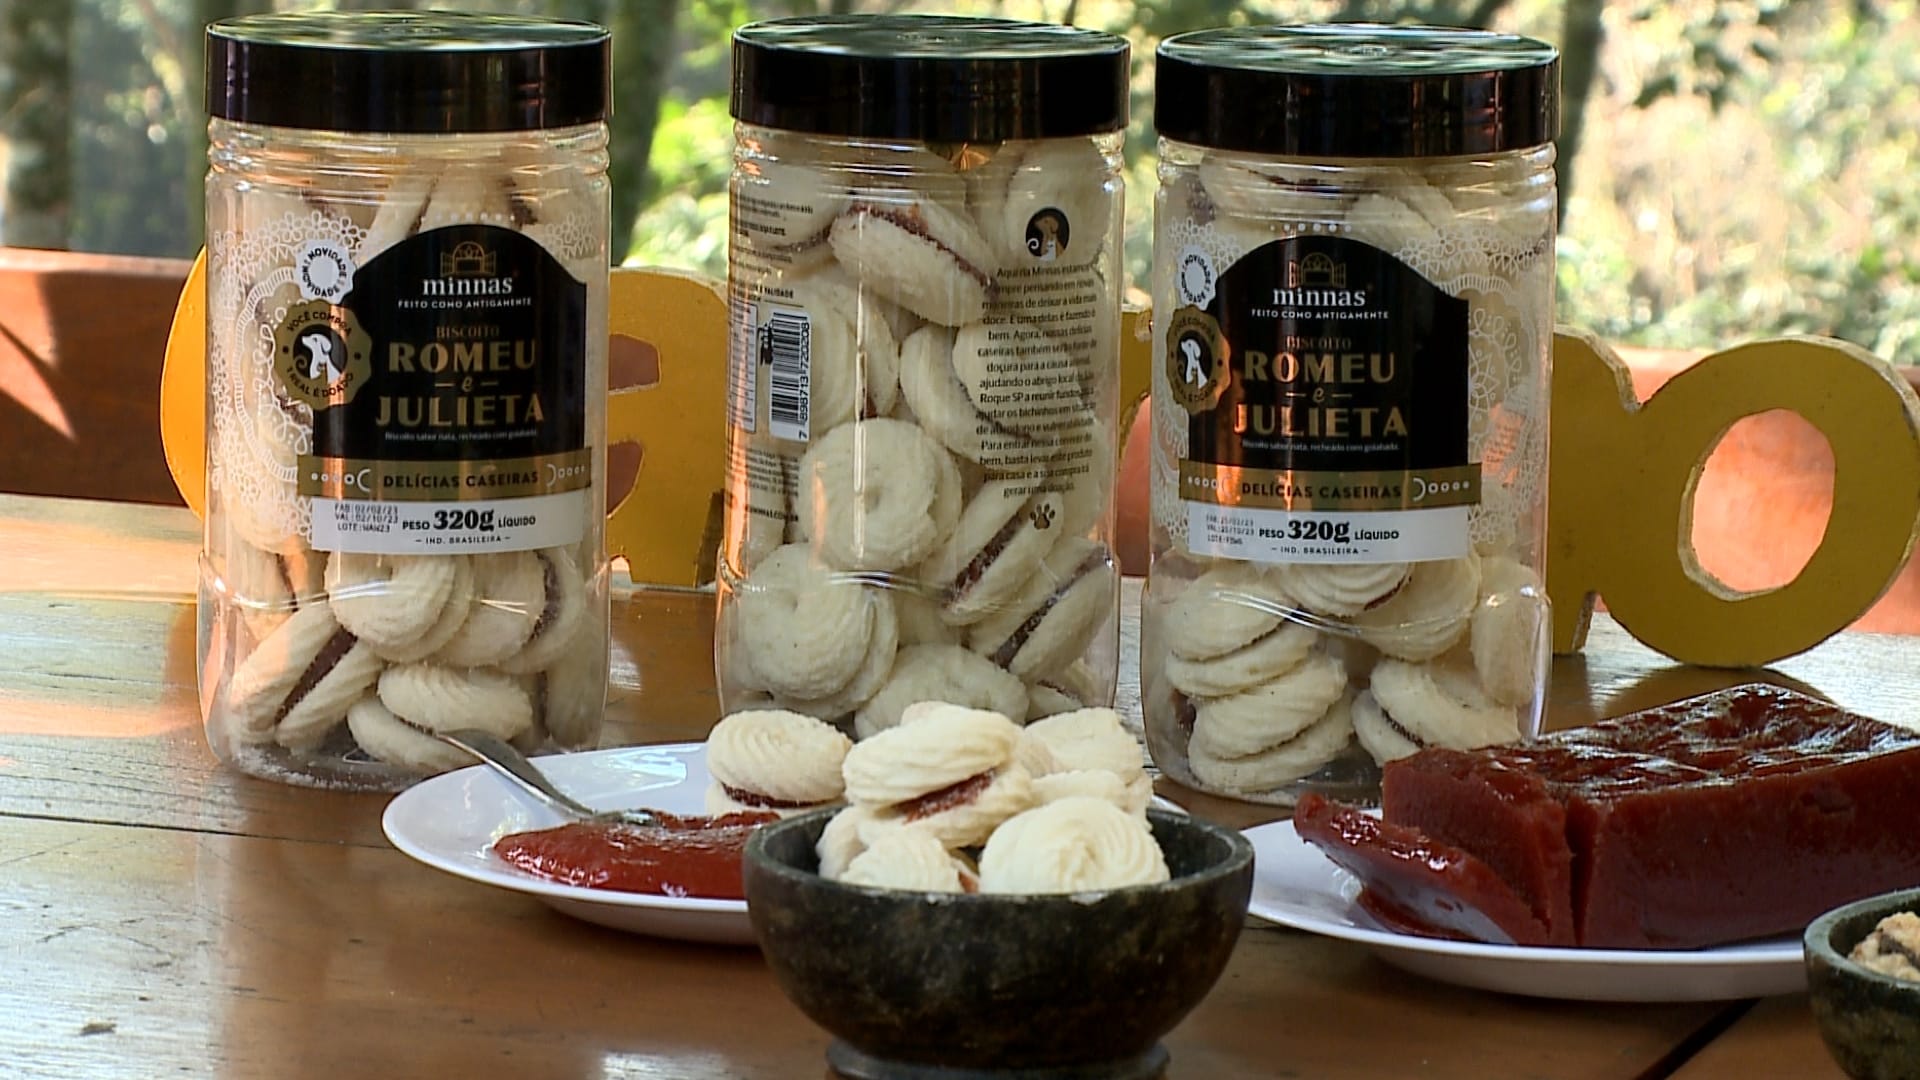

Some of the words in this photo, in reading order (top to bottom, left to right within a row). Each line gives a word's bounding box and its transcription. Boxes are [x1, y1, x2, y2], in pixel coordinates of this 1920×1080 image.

[423, 276, 513, 296] minnas
[398, 299, 428, 309] FEITO
[431, 300, 463, 309] COMO
[466, 297, 532, 309] ANTIGAMENTE
[1273, 288, 1366, 306] minnas
[1251, 308, 1279, 319] FEITO
[1281, 310, 1312, 319] COMO
[1315, 311, 1390, 320] ANTIGAMENTE
[436, 325, 500, 339] BISCOITO
[388, 340, 537, 374] ROMEU
[1244, 350, 1395, 384] ROMEU
[1312, 387, 1325, 403] e
[375, 393, 545, 427] JULIETA
[1233, 403, 1408, 438] JULIETA
[383, 473, 460, 489] DELÍCIAS
[466, 471, 539, 487] CASEIRAS
[1242, 481, 1313, 498] DELÍCIAS
[1319, 484, 1402, 499] CASEIRAS
[402, 520, 430, 531] PESO
[432, 508, 495, 532] 320g
[498, 514, 536, 529] LÍQUIDO
[425, 536, 446, 545] IND.
[449, 535, 502, 544] BRASILEIRA
[1258, 527, 1285, 539] PESO
[1287, 519, 1350, 544] 320g
[1354, 528, 1400, 541] LÍQUIDO
[1280, 546, 1300, 555] IND.
[1303, 546, 1359, 555] BRASILEIRA
